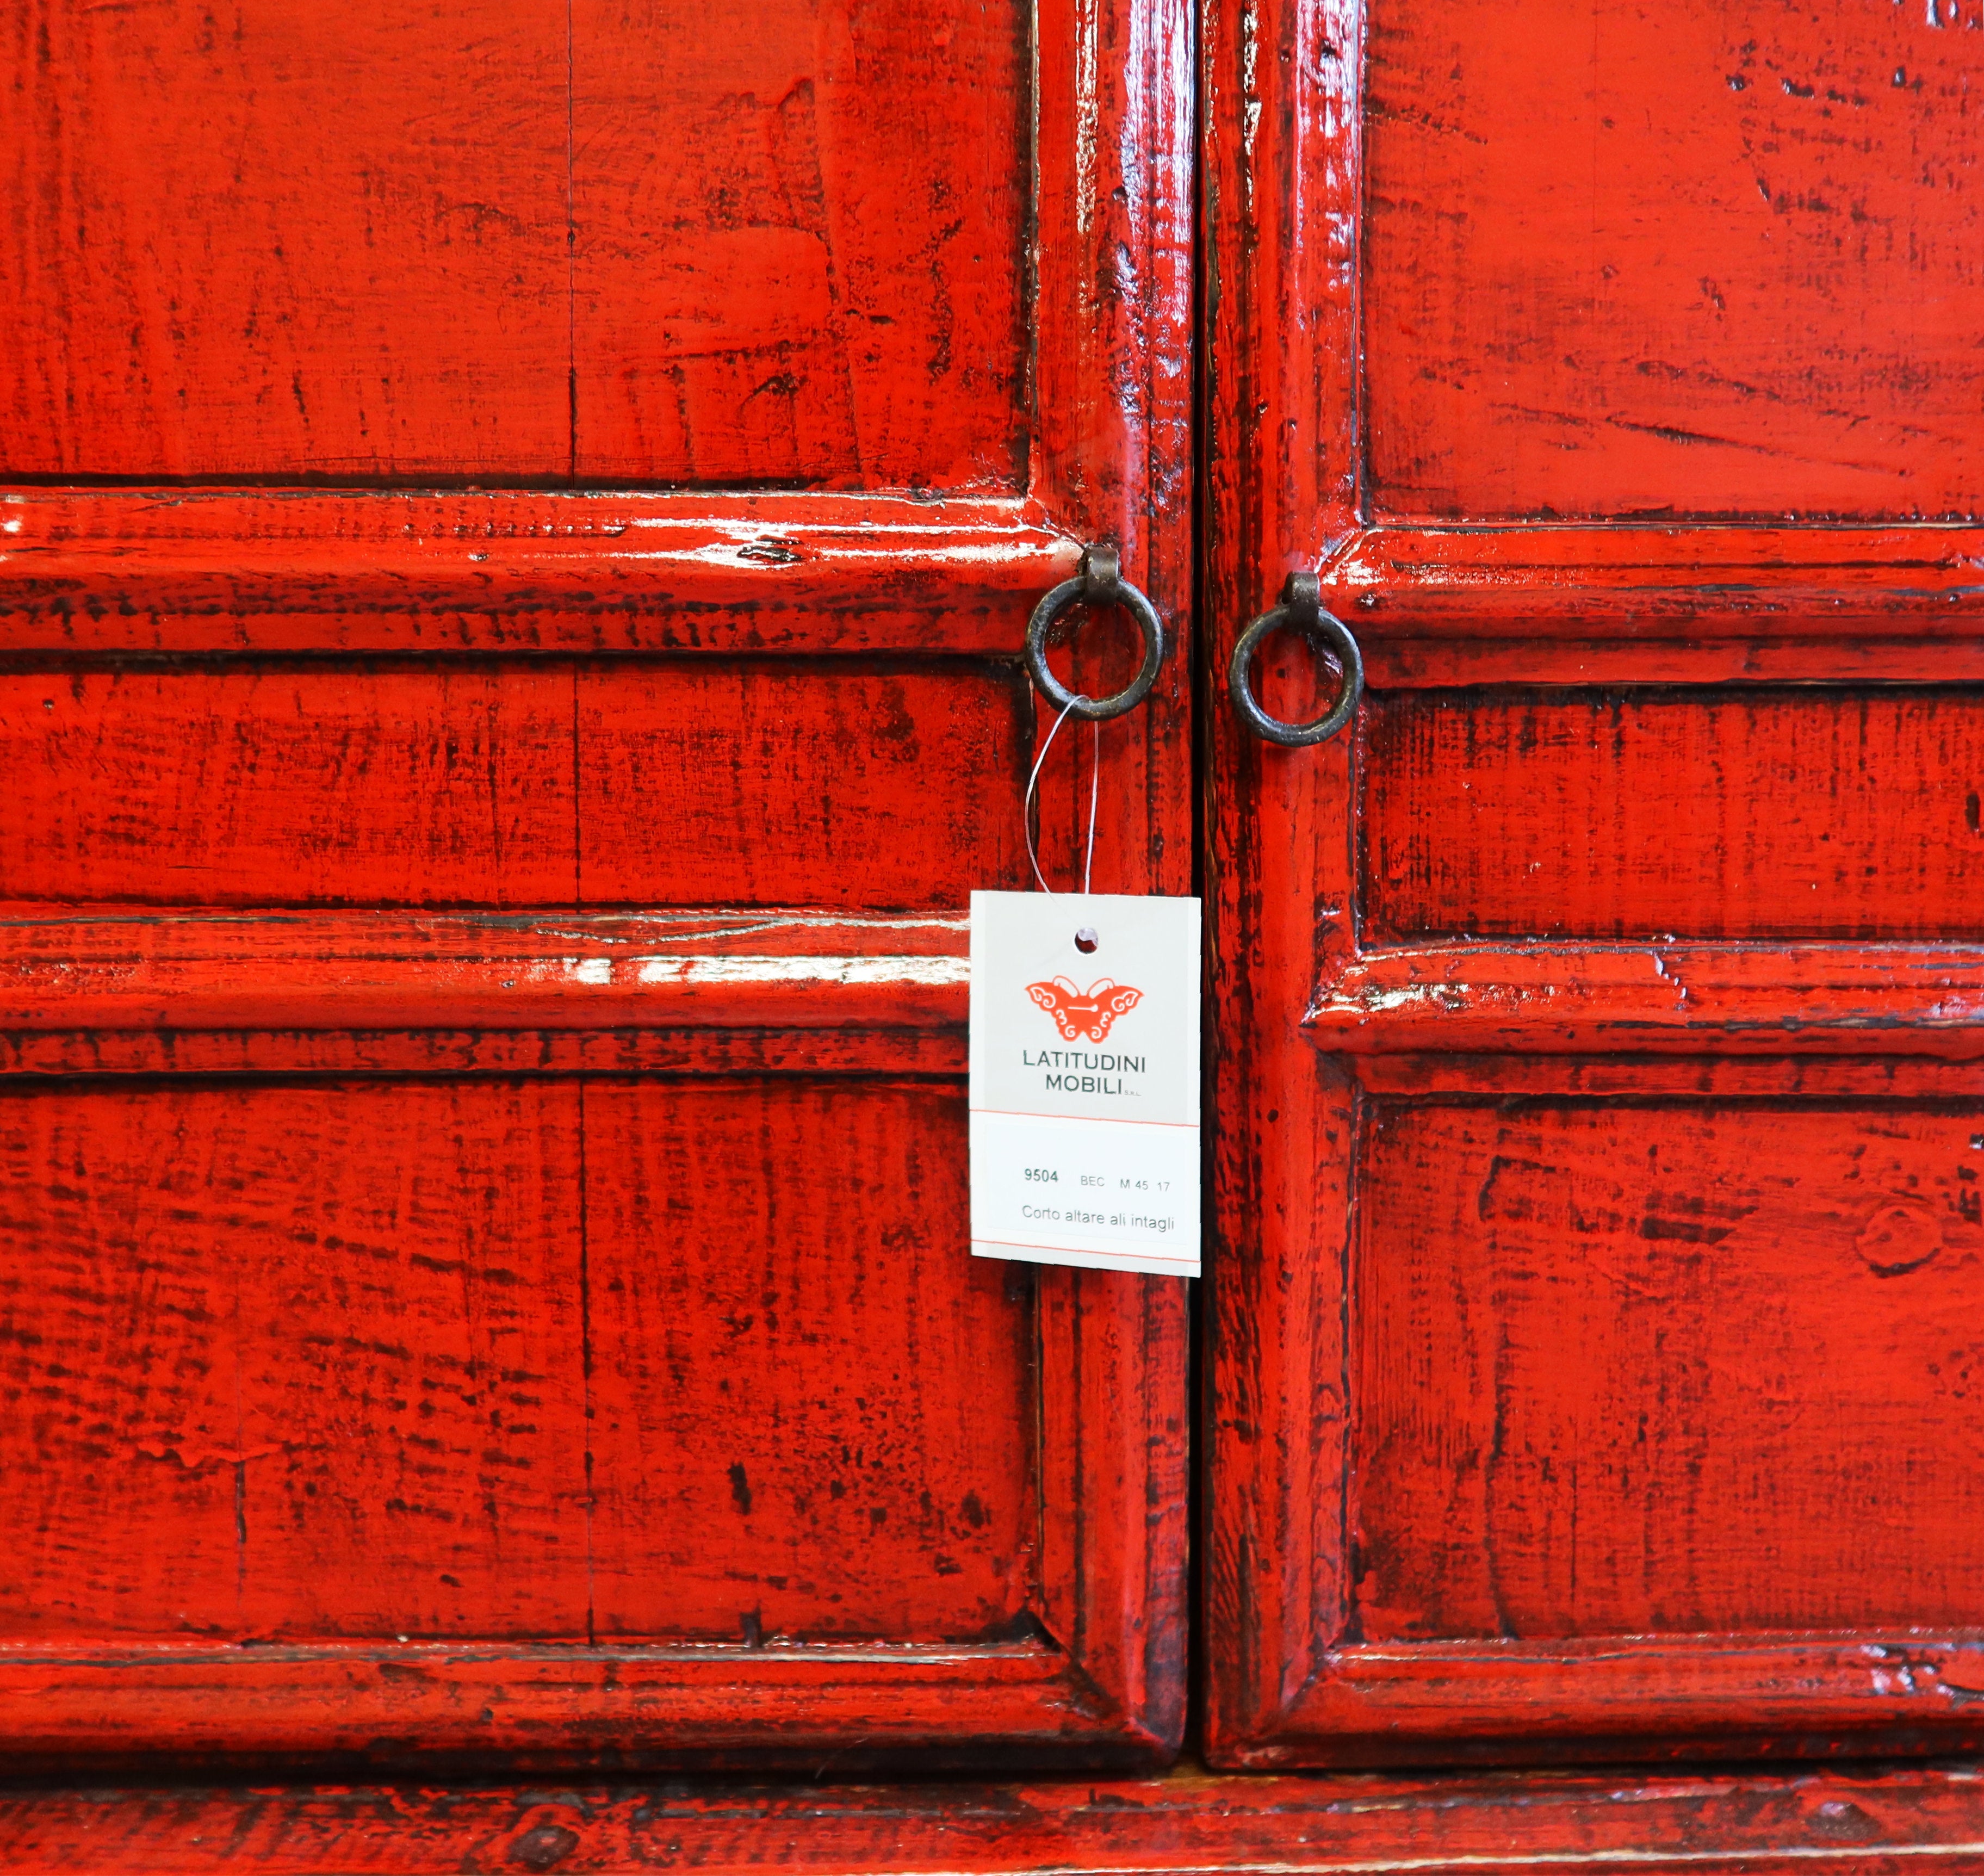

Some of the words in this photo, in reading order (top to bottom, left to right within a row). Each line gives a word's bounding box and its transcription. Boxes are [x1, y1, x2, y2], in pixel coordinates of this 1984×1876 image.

[1023, 1050, 1146, 1073] LATITUDINI
[1045, 1074, 1122, 1095] MOBILI
[1024, 1168, 1058, 1182] 9504
[1081, 1175, 1105, 1187] BEC
[1120, 1179, 1130, 1188] M
[1135, 1180, 1149, 1190] 45
[1157, 1181, 1170, 1192] 17
[1022, 1205, 1060, 1220] Corto
[1065, 1210, 1105, 1224] altare
[1110, 1213, 1126, 1226] ali
[1131, 1214, 1174, 1233] intagli
